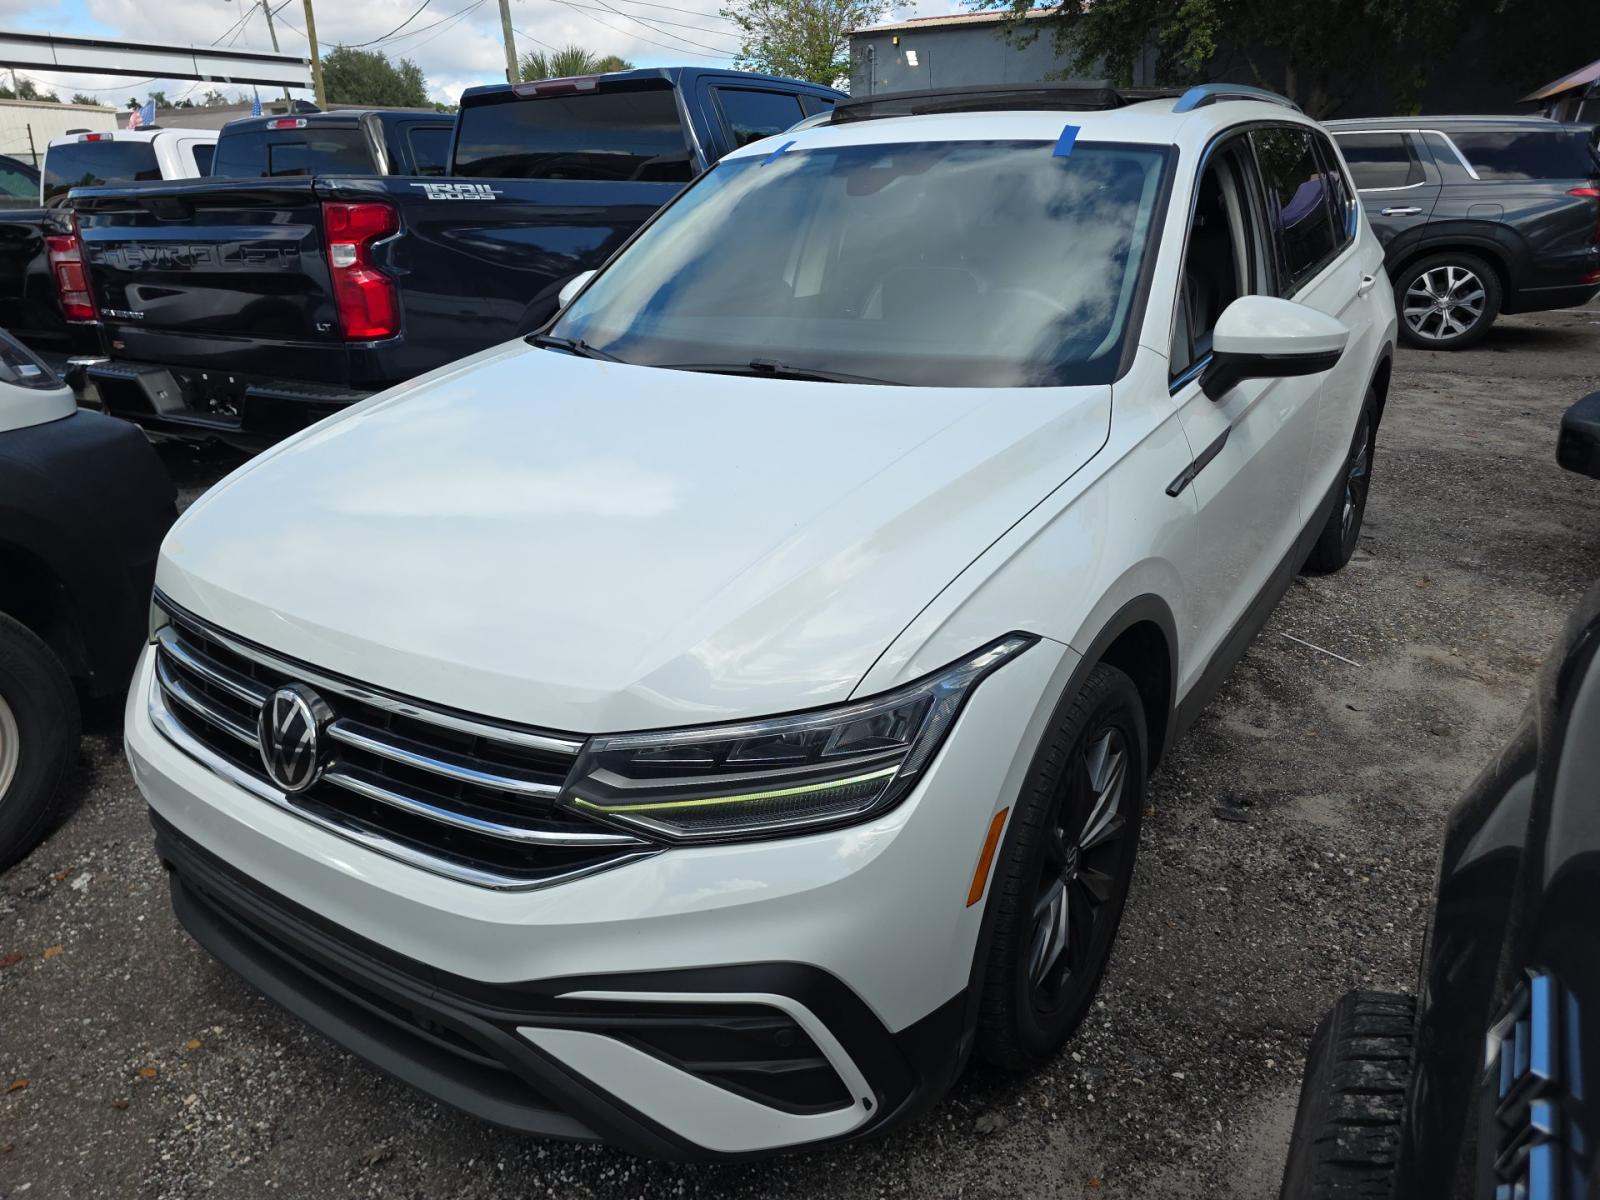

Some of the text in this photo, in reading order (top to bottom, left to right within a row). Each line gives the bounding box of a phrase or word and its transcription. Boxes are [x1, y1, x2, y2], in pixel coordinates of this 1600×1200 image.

[409, 183, 503, 193] TRAIL
[427, 192, 496, 200] BOSS
[316, 322, 332, 332] LT
